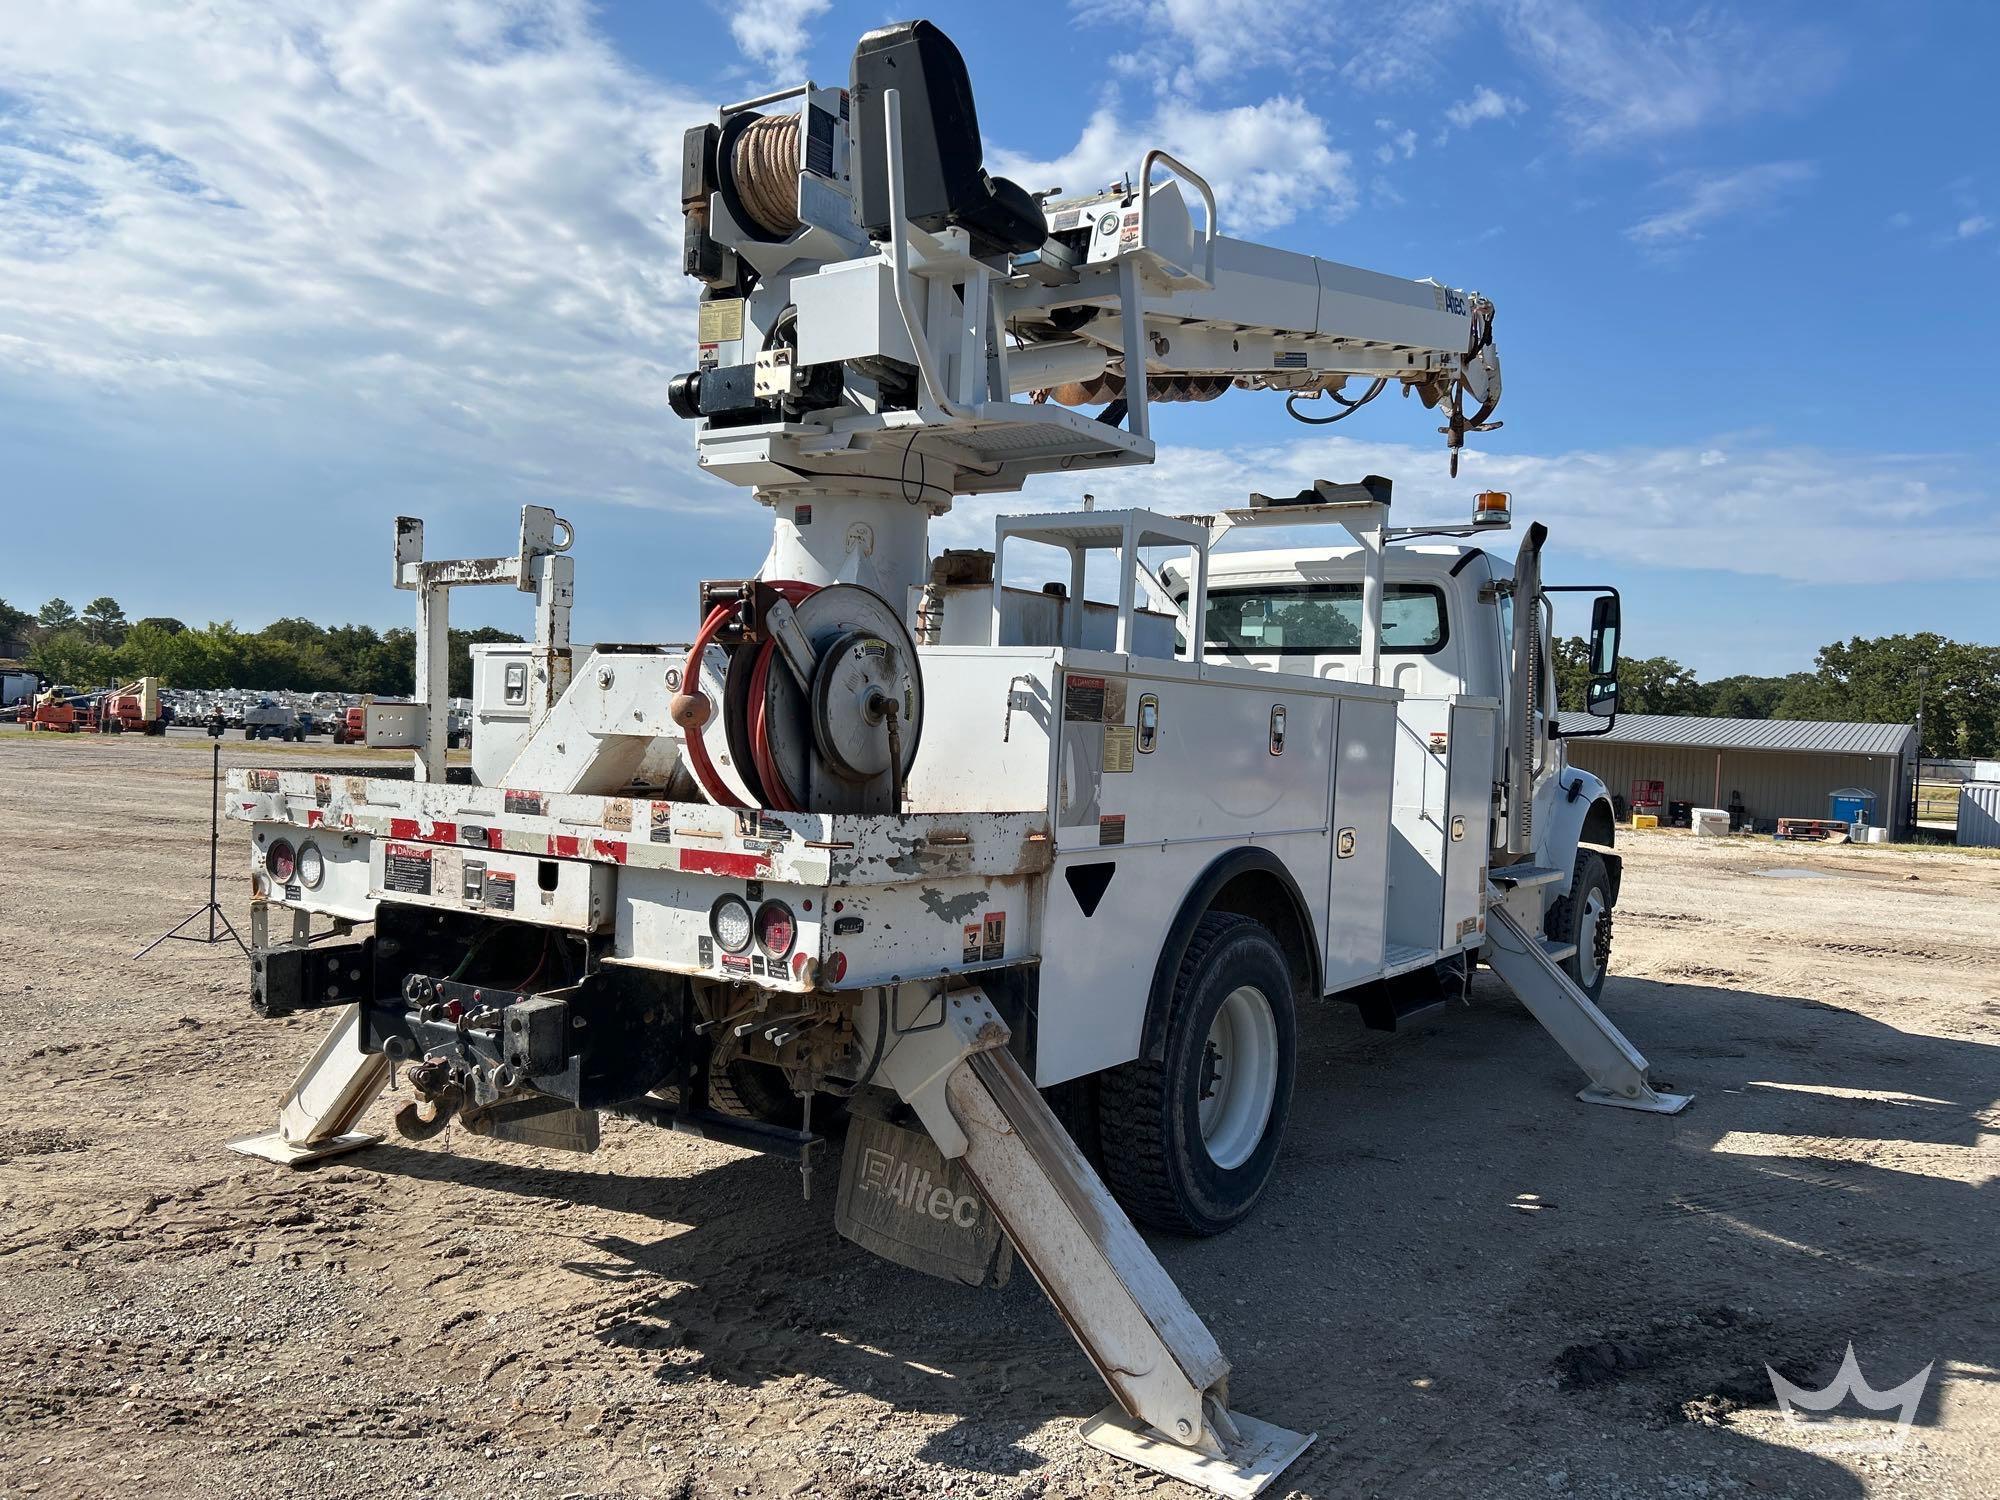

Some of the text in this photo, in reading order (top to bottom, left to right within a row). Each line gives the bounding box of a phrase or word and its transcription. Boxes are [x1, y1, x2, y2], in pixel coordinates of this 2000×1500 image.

[1445, 289, 1466, 316] Altec
[613, 804, 623, 812] NO
[604, 816, 632, 826] ACCESS
[397, 846, 425, 858] DANGER
[886, 1161, 979, 1228] Altec
